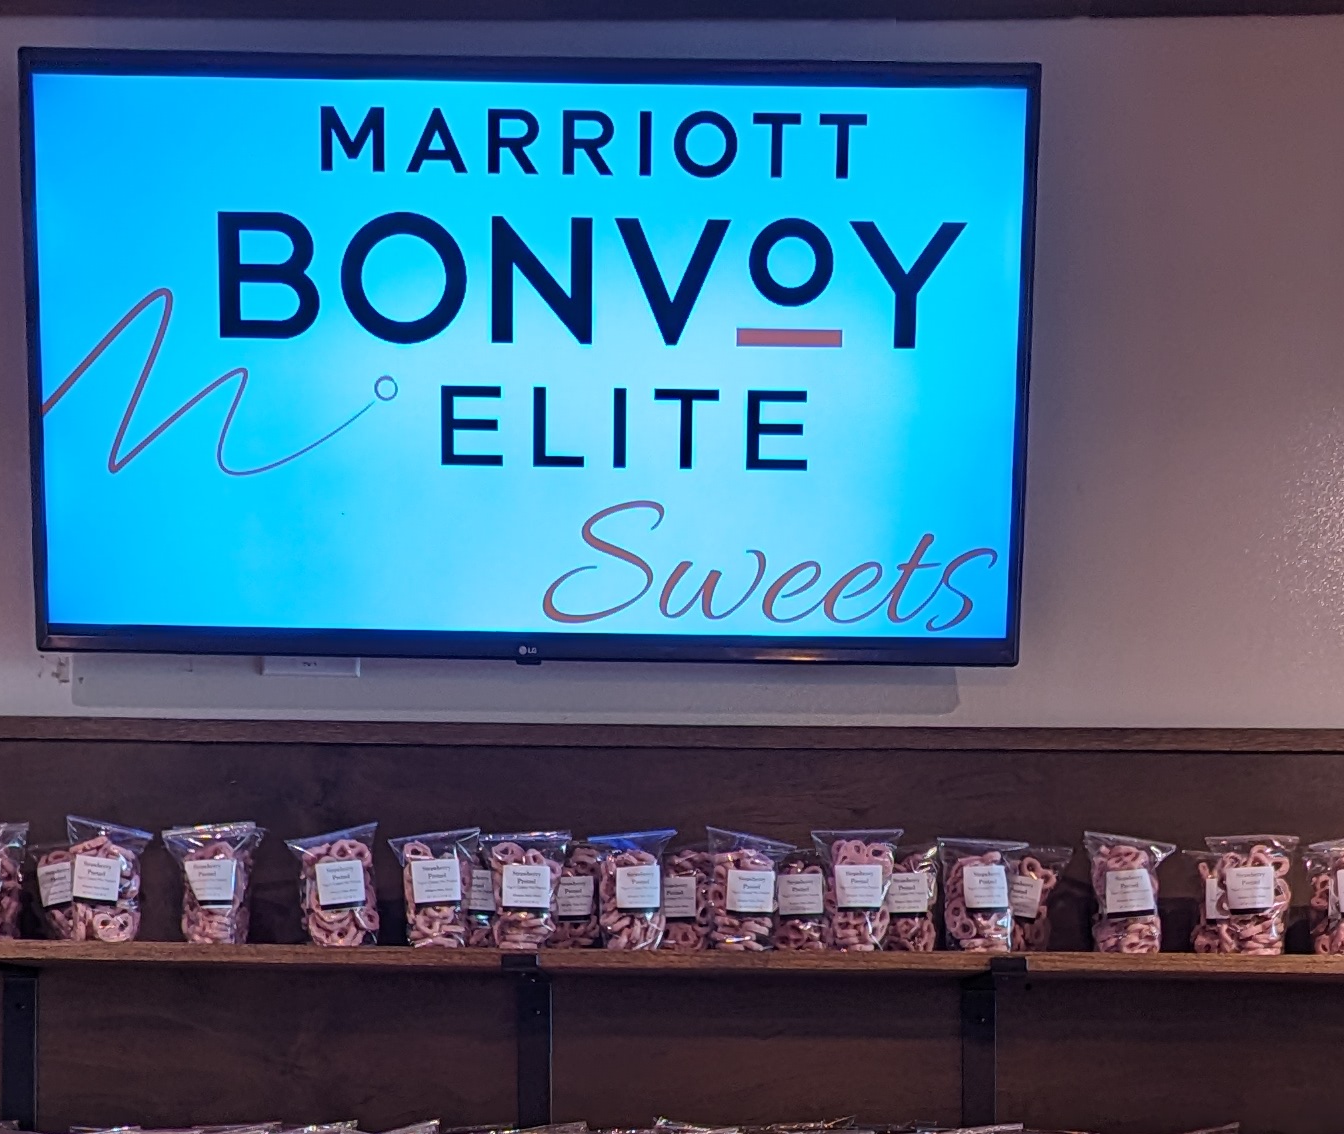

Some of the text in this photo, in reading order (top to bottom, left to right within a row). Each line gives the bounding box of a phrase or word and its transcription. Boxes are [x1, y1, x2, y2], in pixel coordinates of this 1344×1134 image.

[320, 105, 868, 179] MARRIOTT
[217, 210, 967, 349] BONVOY
[440, 385, 809, 472] ELITE
[542, 500, 999, 632] Sweets
